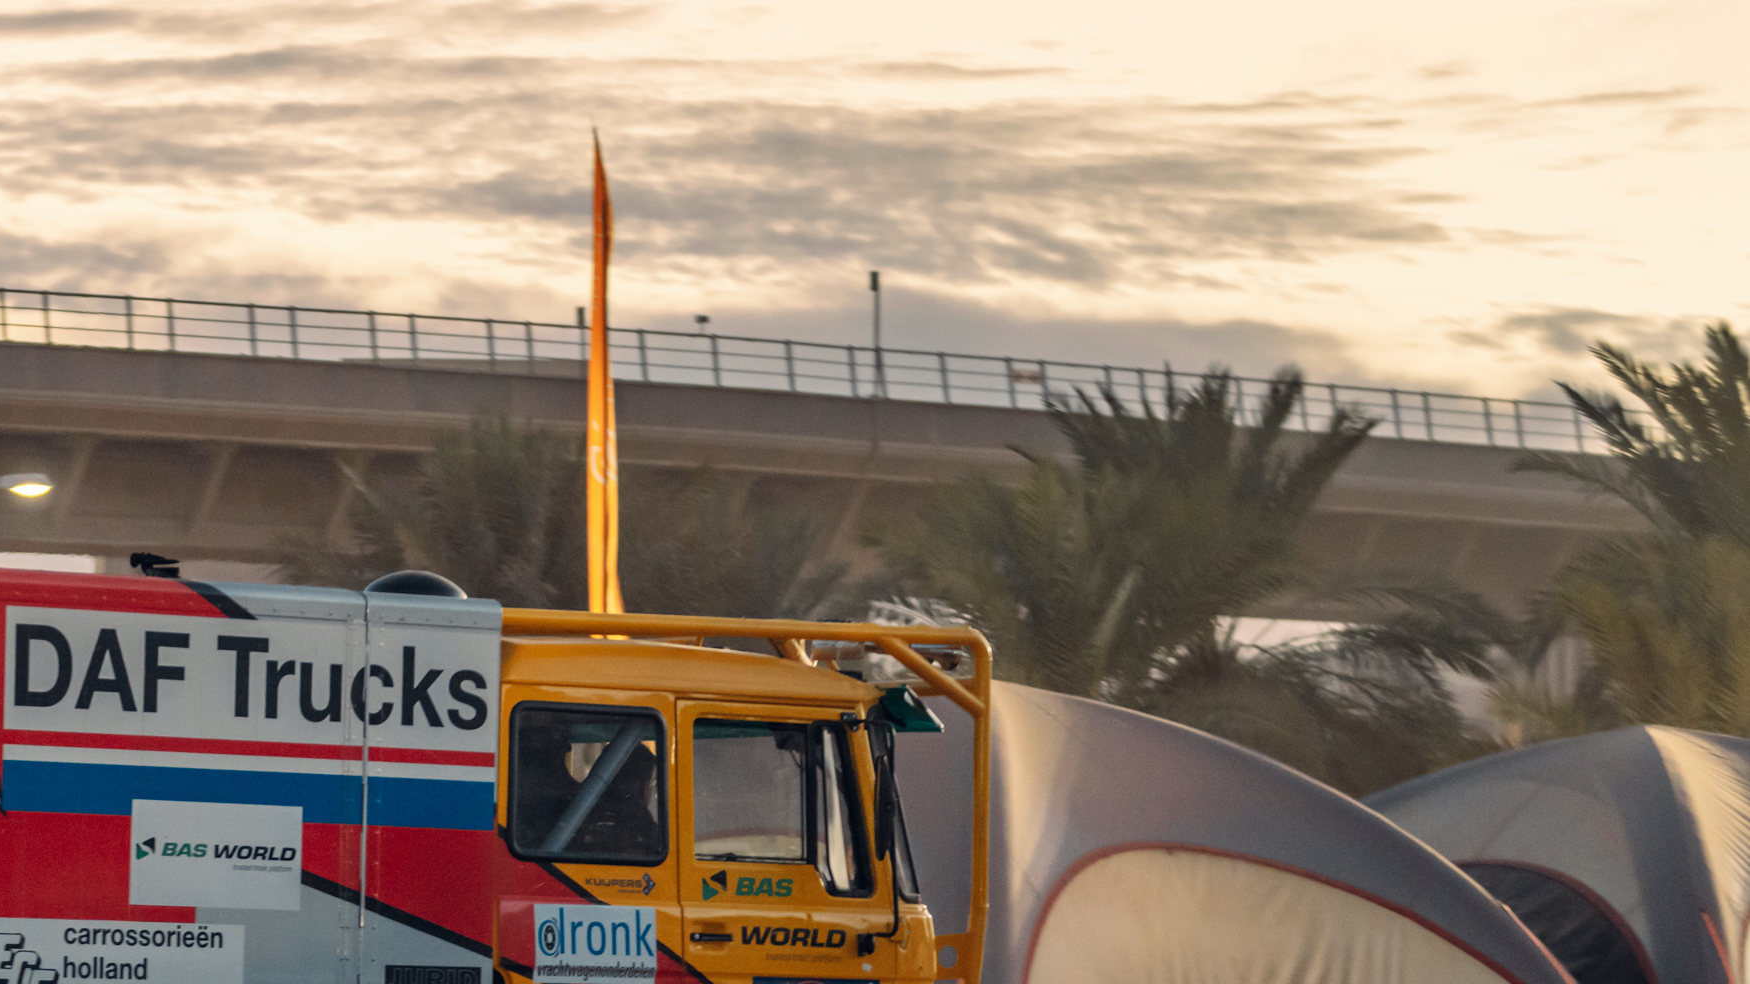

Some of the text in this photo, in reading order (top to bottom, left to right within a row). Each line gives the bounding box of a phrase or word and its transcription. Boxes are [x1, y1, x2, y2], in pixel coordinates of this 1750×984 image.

[13, 622, 489, 731] DAF Trucks
[161, 842, 297, 862] BAS WORLD
[736, 877, 793, 897] BAS
[64, 925, 224, 949] carrossorieën
[538, 907, 654, 957] dronk
[741, 926, 846, 948] WORLD
[63, 956, 147, 980] holland
[536, 960, 655, 981] vrachtwagenonderdelen
